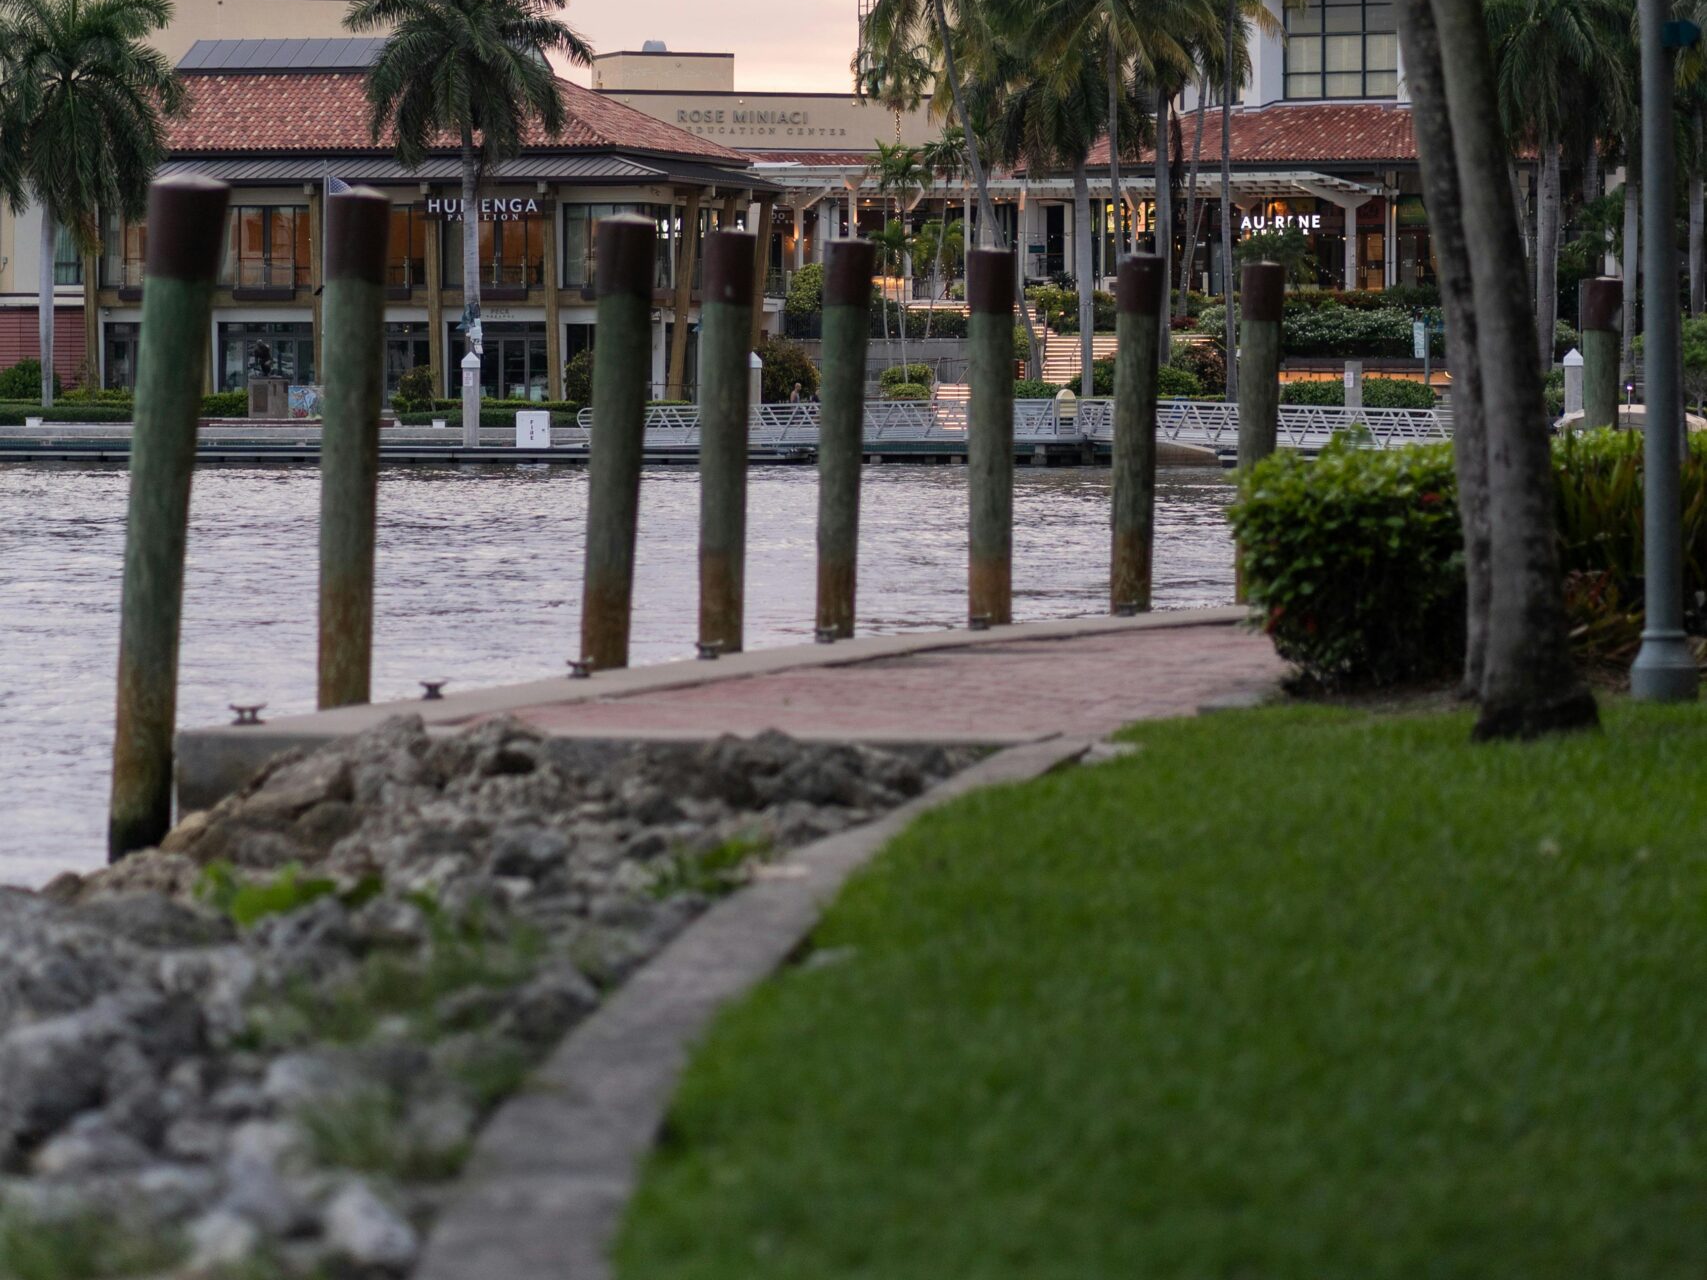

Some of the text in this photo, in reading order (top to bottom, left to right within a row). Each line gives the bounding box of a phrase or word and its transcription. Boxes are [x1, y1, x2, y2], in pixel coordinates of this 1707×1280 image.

[677, 109, 809, 125] ROSE MINIACI
[686, 126, 847, 136] EDUCATION CENTER
[428, 198, 538, 213] HUIENGA
[448, 213, 519, 221] PALION
